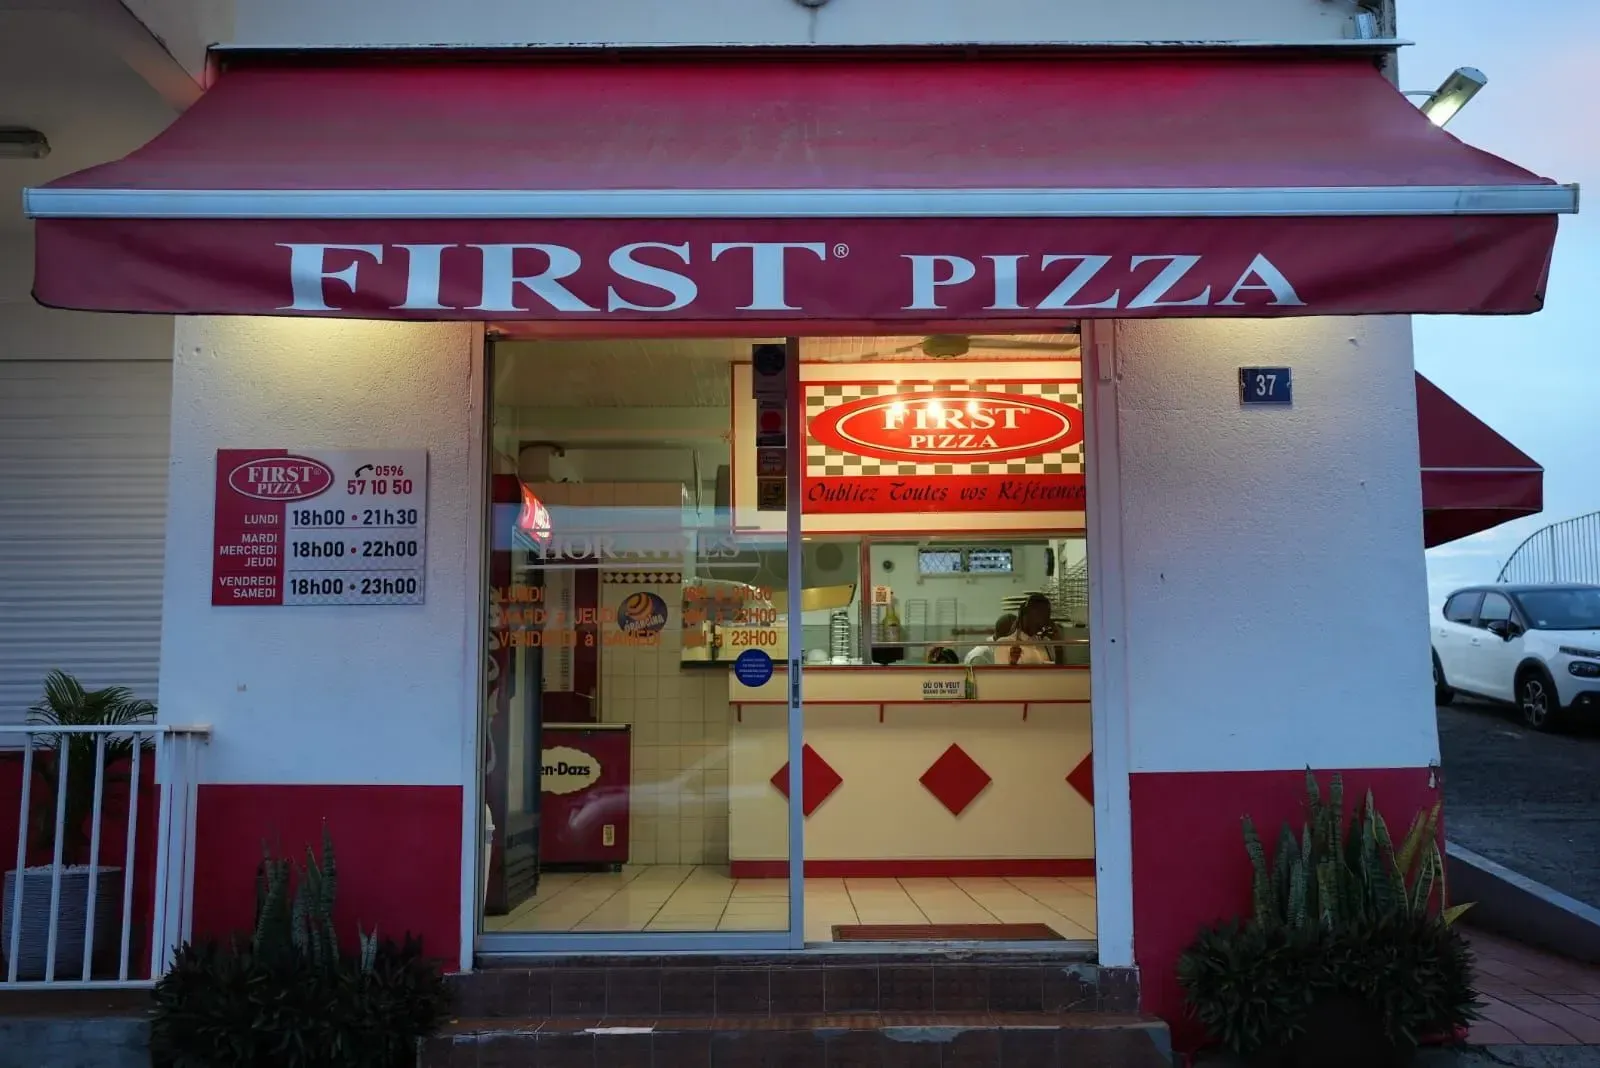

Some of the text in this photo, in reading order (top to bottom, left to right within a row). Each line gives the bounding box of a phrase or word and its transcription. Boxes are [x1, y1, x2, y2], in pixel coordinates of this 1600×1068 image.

[900, 252, 1308, 311] PIZZA
[1256, 374, 1277, 396] 37
[909, 434, 999, 449] PIZZA
[375, 465, 404, 476] 0596
[257, 483, 302, 495] PIZZA
[347, 479, 413, 495] 57 10 50
[244, 509, 418, 526] LUNDI 18h00 21h30
[241, 533, 278, 543] MARDI
[220, 541, 418, 558] MERCREDI 18h00 22h00
[244, 557, 277, 567] JEUDI
[219, 575, 276, 586] VENDREDI
[291, 578, 417, 595] 18h00 23h00
[233, 588, 276, 599] SAMEDI
[500, 631, 577, 648] VENDDI
[732, 630, 777, 646] 23H00
